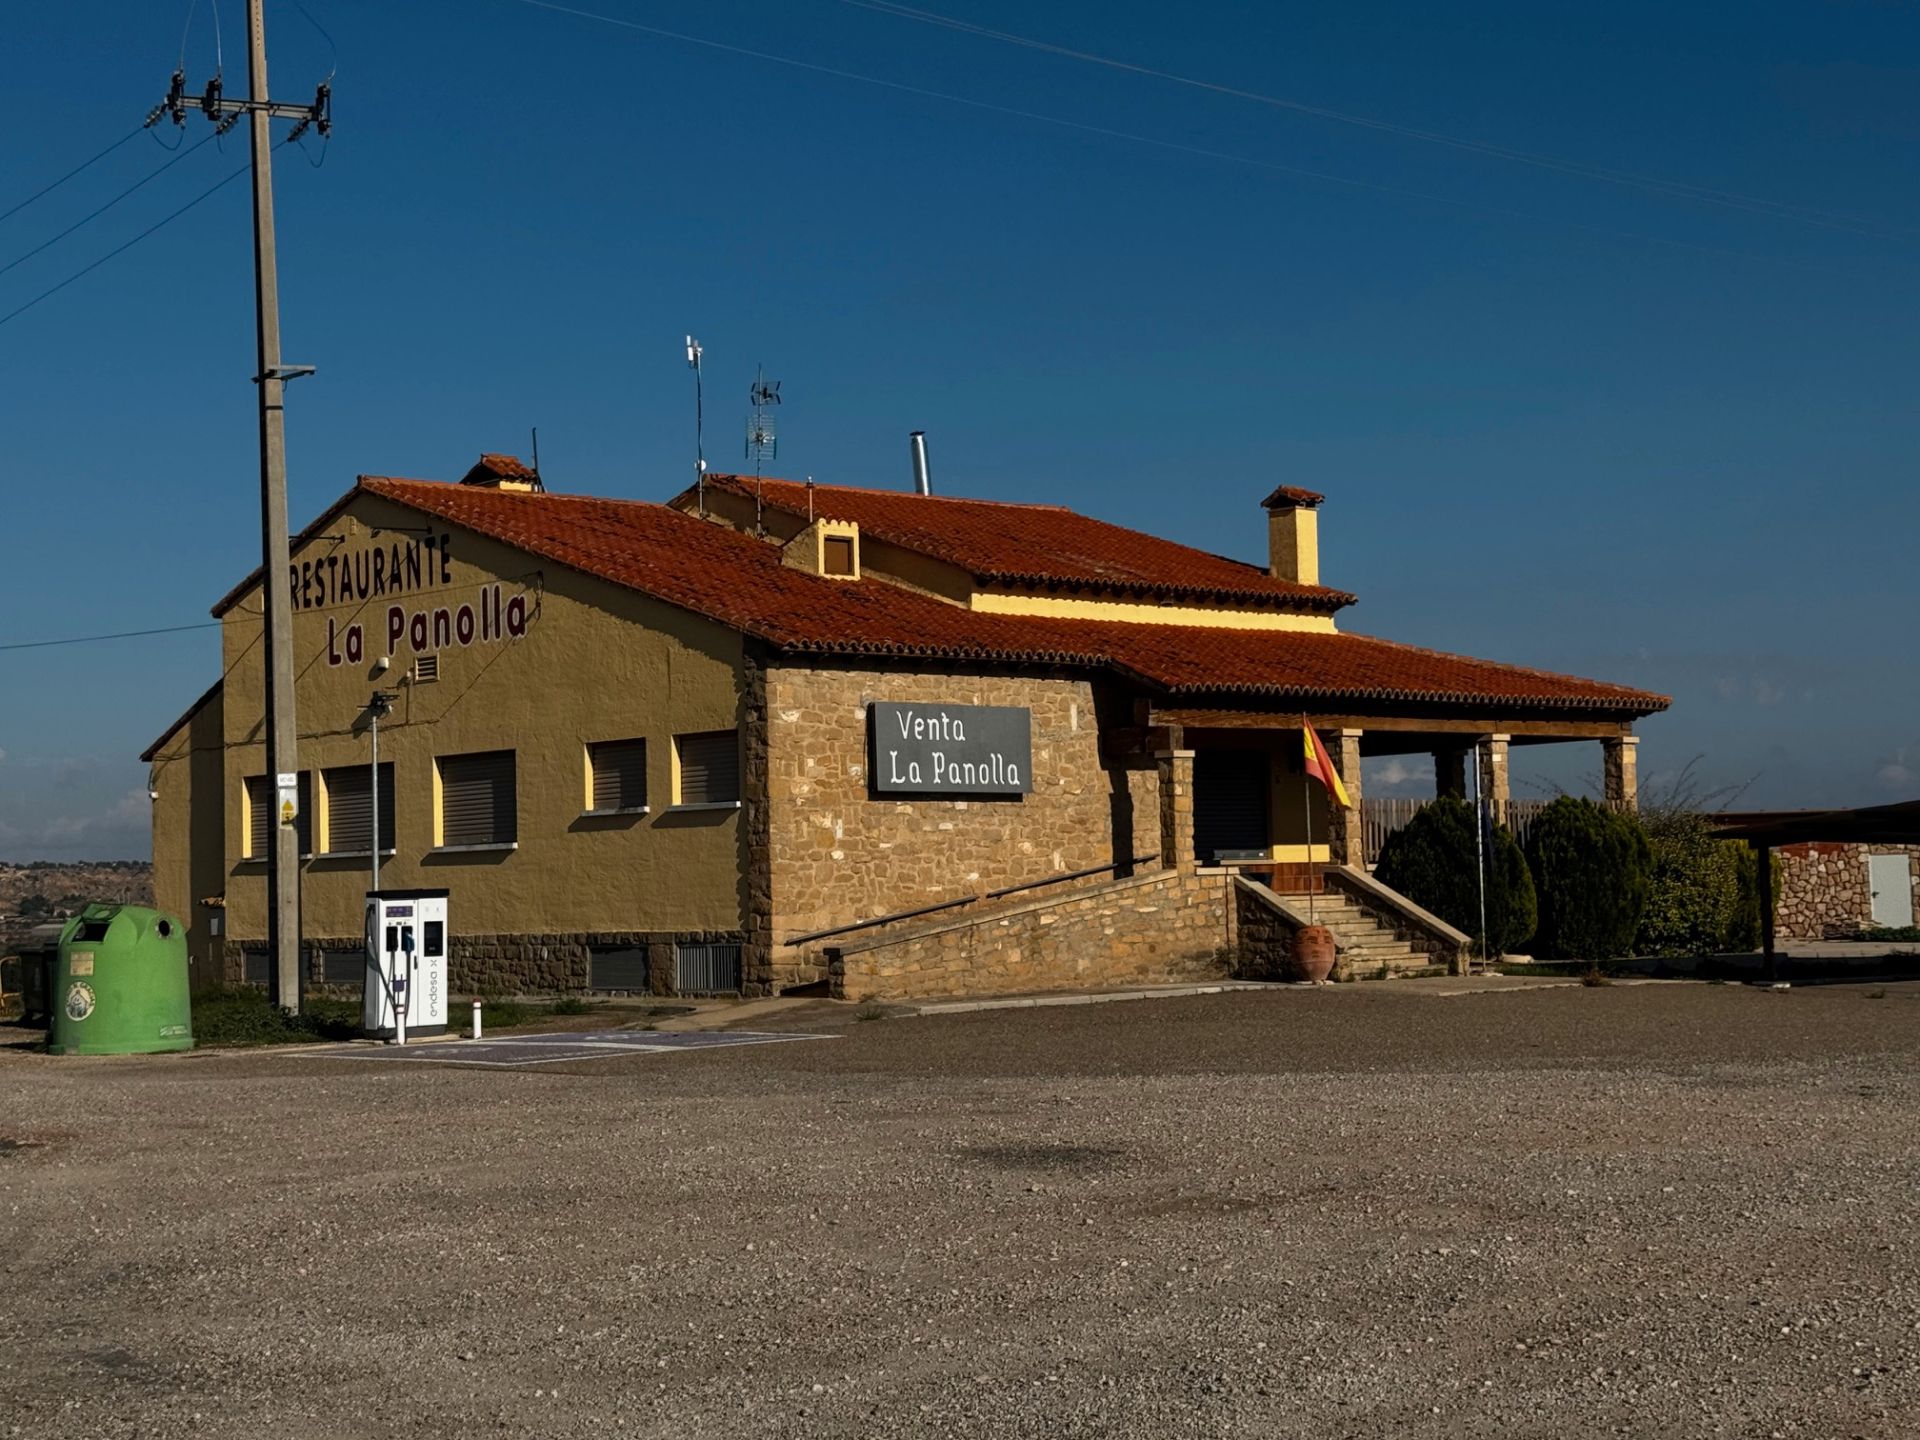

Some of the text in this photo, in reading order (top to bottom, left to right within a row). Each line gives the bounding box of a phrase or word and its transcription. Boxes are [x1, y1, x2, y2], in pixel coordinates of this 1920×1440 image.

[290, 533, 451, 611] RESTAURANTE
[328, 585, 526, 666] La Panolla
[896, 710, 966, 741] Venta
[889, 750, 1021, 785] La Panolla
[430, 971, 438, 1017] endesa
